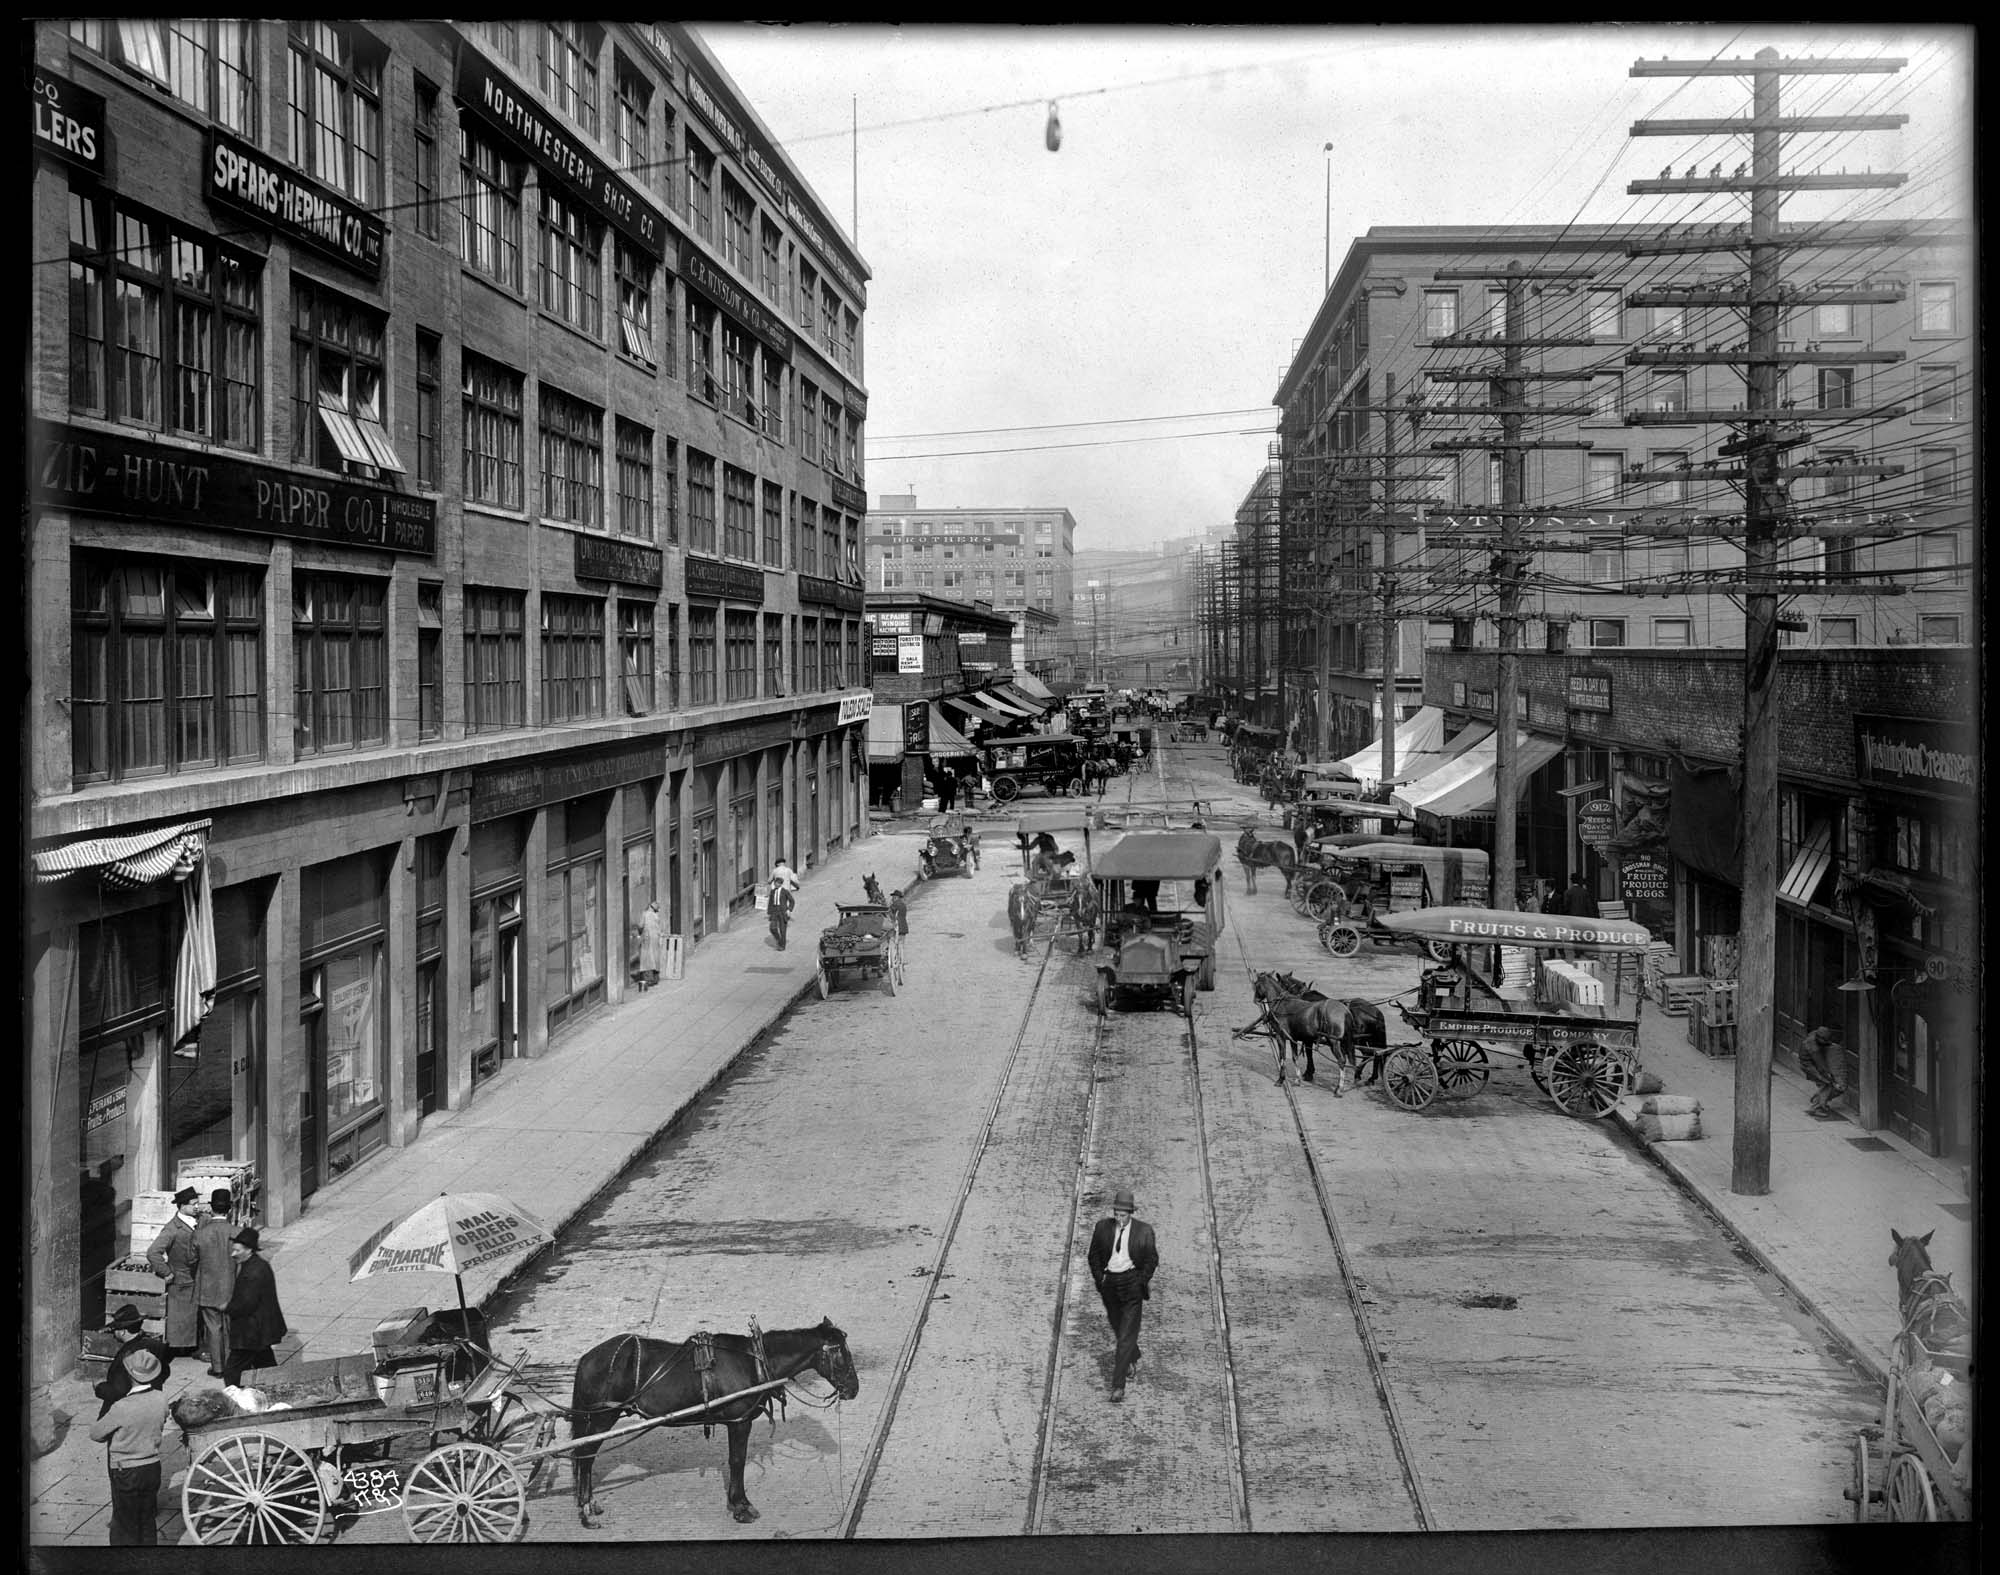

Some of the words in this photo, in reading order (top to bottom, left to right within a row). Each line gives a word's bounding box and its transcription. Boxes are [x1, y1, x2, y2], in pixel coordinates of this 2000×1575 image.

[483, 76, 593, 189] NORTHWESTERN
[604, 183, 632, 222] SHOE
[344, 216, 364, 259] CO.
[708, 270, 741, 312] WINSLOW
[257, 479, 330, 530] PAPER
[345, 496, 377, 537] CO.
[391, 500, 431, 521] WHOLESALE
[394, 519, 425, 547] PAPER
[1591, 803, 1610, 812] 912
[1622, 881, 1669, 889] PRODUCE
[1626, 873, 1664, 881] FRUITS
[1625, 889, 1633, 898] &
[1450, 919, 1526, 938] FRUITS
[1533, 926, 1547, 940] &
[1555, 927, 1647, 945] PRODUCE
[455, 1216, 519, 1246] ORDERS
[456, 1210, 500, 1231] MAIL
[377, 1245, 395, 1258] THE
[461, 1234, 544, 1271] PROMPTLY
[475, 1231, 516, 1254] FILLED
[368, 1258, 391, 1274] BON
[387, 1264, 425, 1273] SEATTLE
